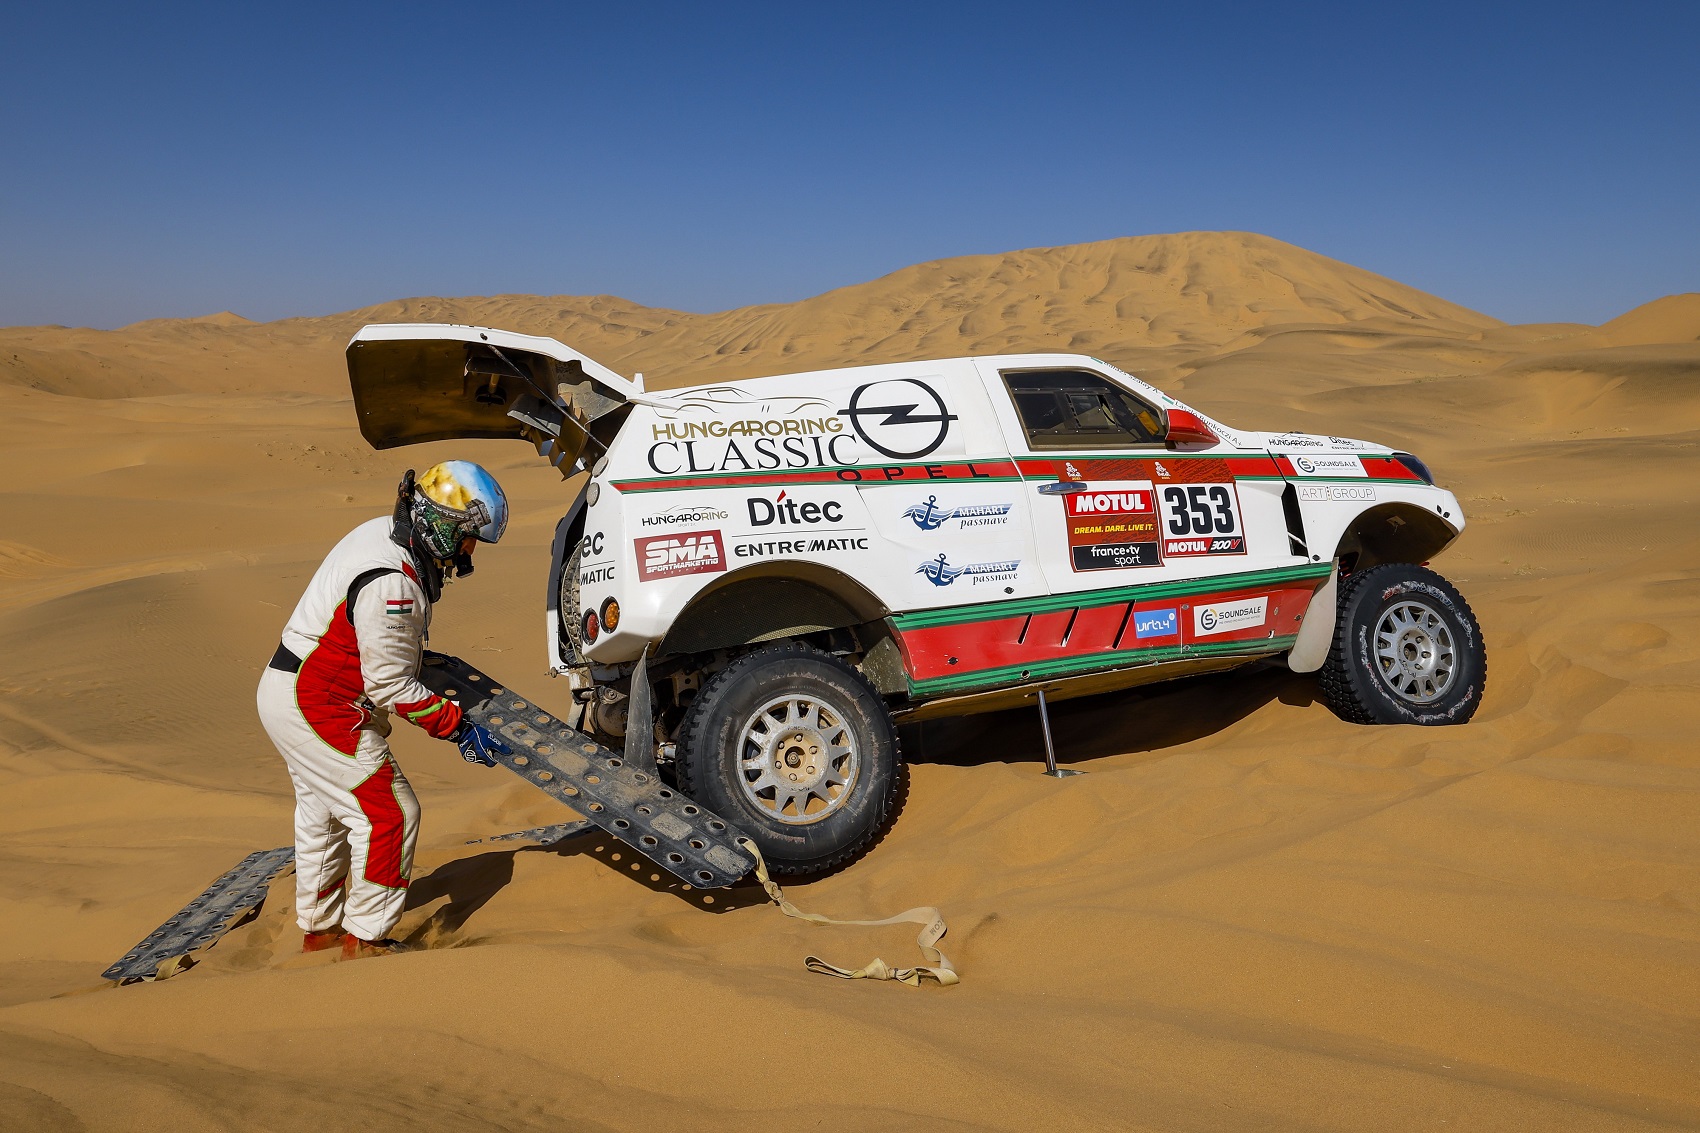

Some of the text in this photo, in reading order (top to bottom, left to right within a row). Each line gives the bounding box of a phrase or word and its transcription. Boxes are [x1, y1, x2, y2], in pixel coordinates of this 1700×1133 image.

[652, 417, 844, 440] HUNGARORING
[1268, 439, 1324, 447] HUNGARORING
[647, 434, 860, 475] CLASSIC
[837, 464, 989, 481] OPEL
[1301, 488, 1373, 499] ART GROUP
[959, 504, 1005, 517] MAHART
[1076, 493, 1145, 513] MOTUL
[1164, 486, 1235, 535] 353
[642, 511, 729, 526] HUNGARORING
[960, 516, 1008, 529] passnave
[1074, 526, 1104, 534] DREAM.
[1105, 524, 1127, 533] DARE.
[1143, 523, 1154, 531] IT.
[645, 535, 719, 567] SMA
[1167, 538, 1241, 553] MOTUL 300V
[970, 561, 1015, 574] MAHART
[1115, 554, 1141, 566] sport
[972, 572, 1019, 586] passnave
[1218, 605, 1262, 620] SOUNDSALE
